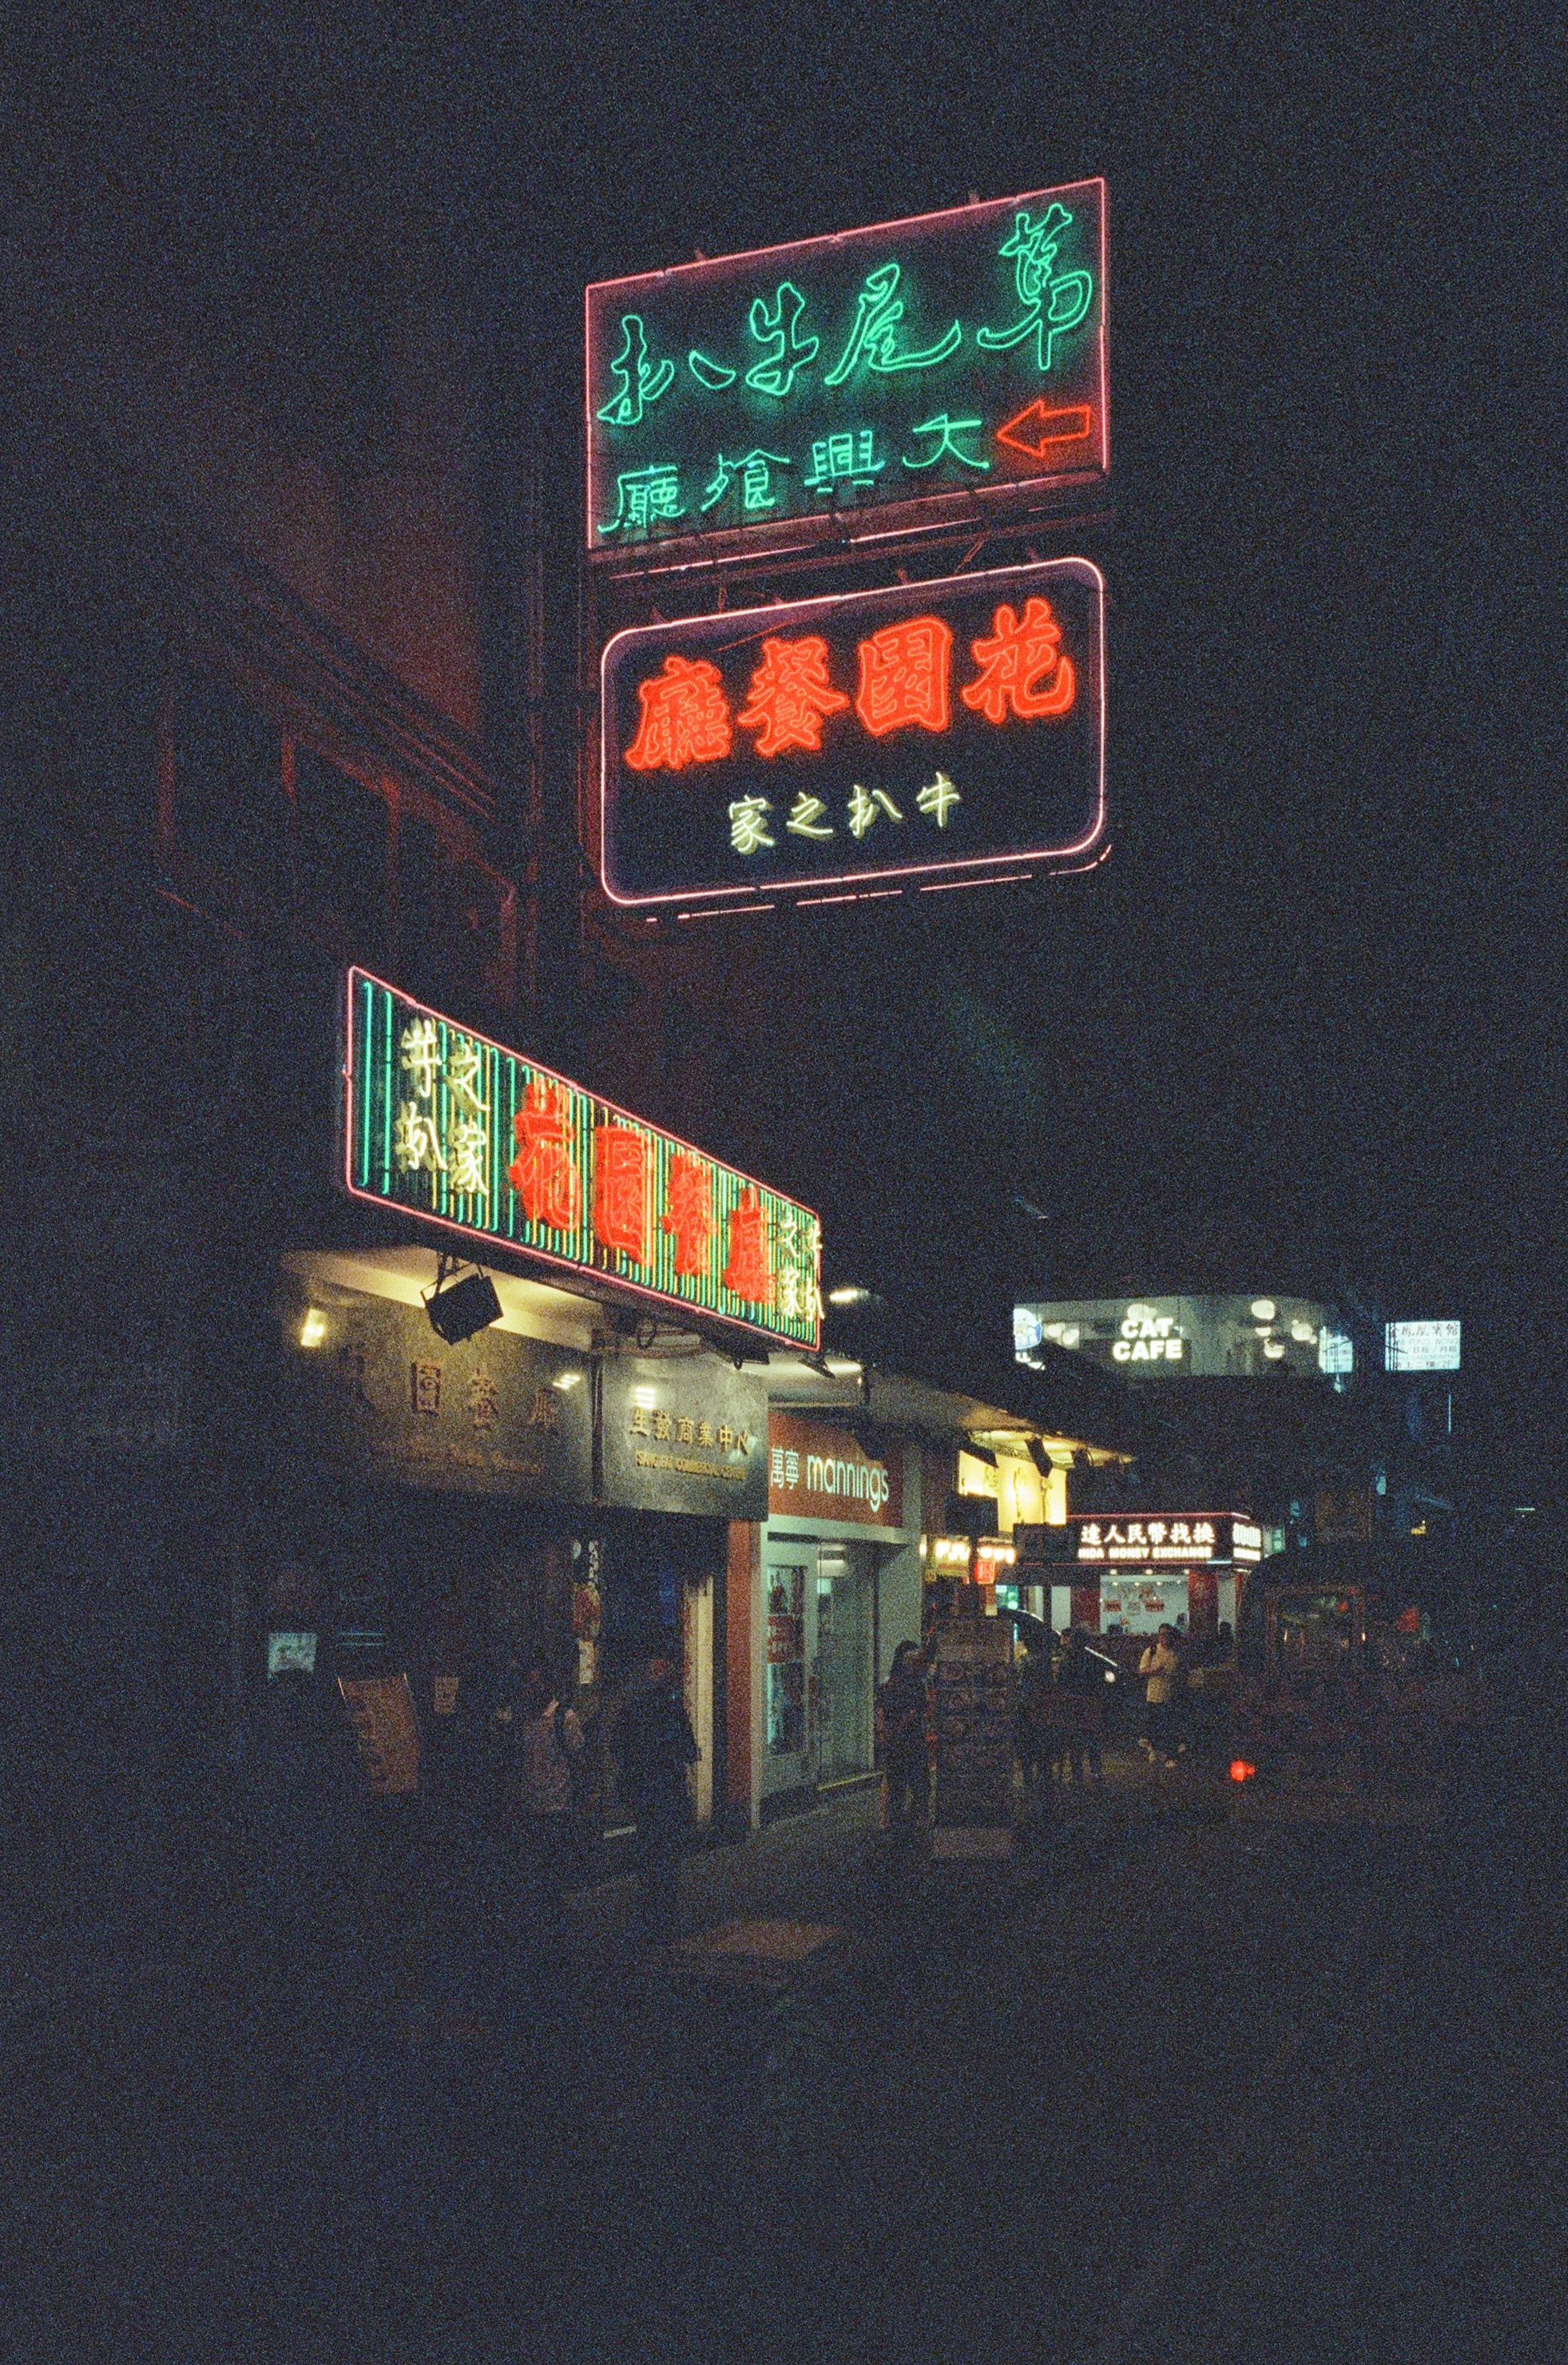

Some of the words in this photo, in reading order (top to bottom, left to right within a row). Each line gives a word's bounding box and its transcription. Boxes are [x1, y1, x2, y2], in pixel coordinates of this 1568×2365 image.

[625, 598, 1075, 770] 花園餐廳
[728, 772, 961, 853] 牛扒之家
[1113, 1339, 1182, 1361] CAFE
[1121, 1318, 1174, 1339] CAT
[770, 1445, 800, 1490] 萬寧
[807, 1453, 890, 1512] mannings
[1109, 1547, 1149, 1559] MONEY
[1152, 1546, 1213, 1559] EXCHANGE
